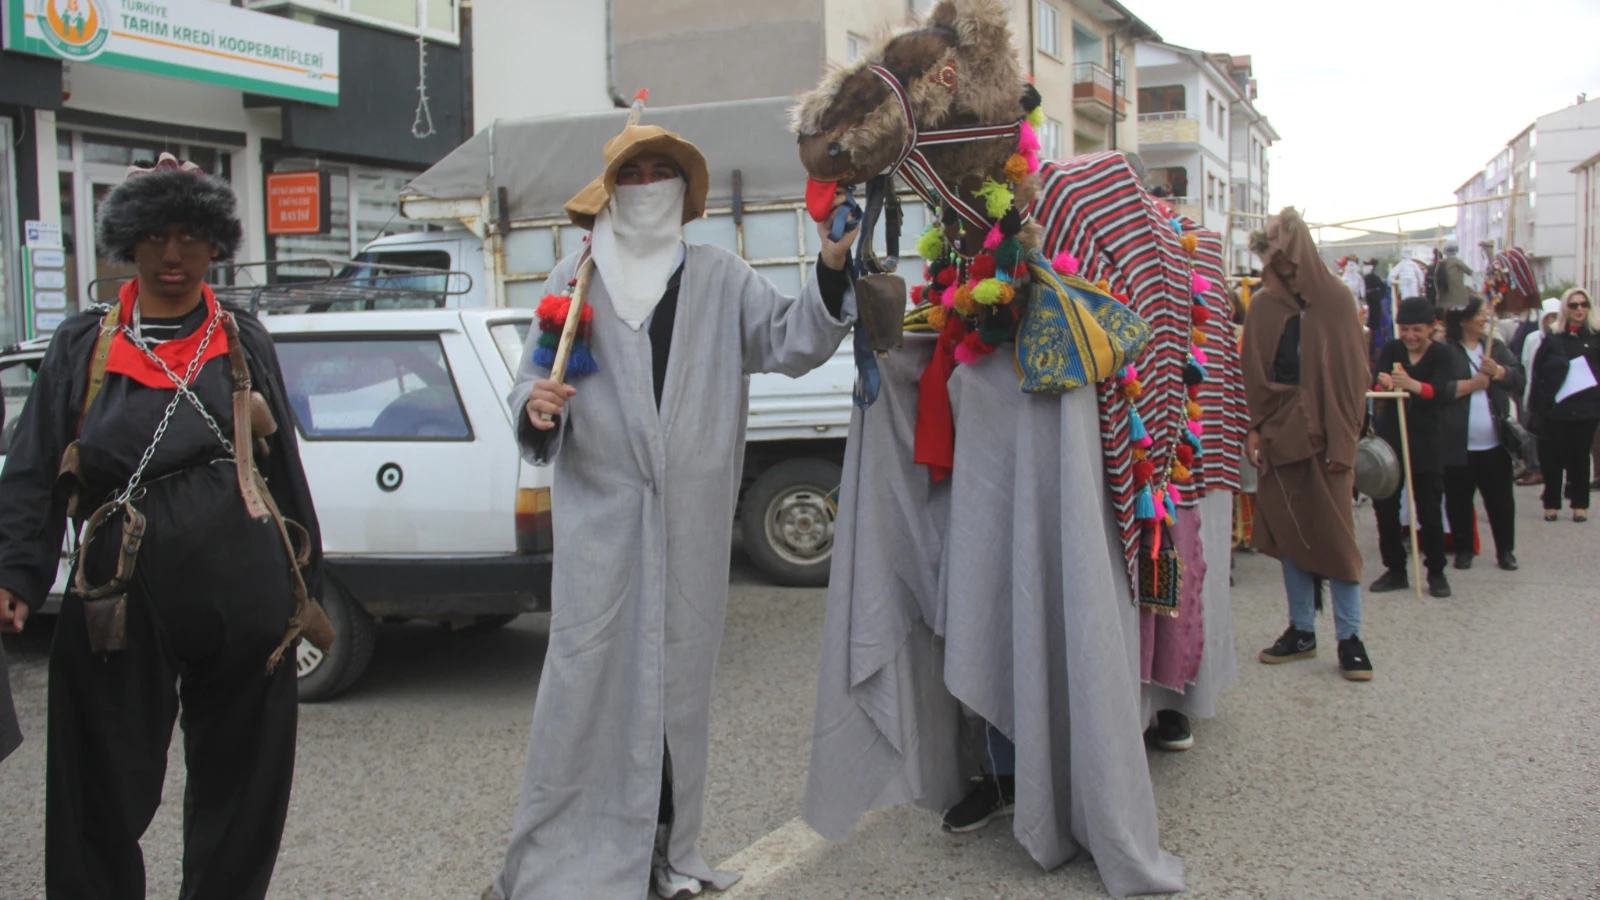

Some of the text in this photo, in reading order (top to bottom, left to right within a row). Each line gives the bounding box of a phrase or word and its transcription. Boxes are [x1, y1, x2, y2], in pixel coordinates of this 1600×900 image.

[121, 14, 168, 38] TARIM
[172, 25, 215, 47] KREDİ
[218, 34, 324, 68] KOOPERATİFLERİ
